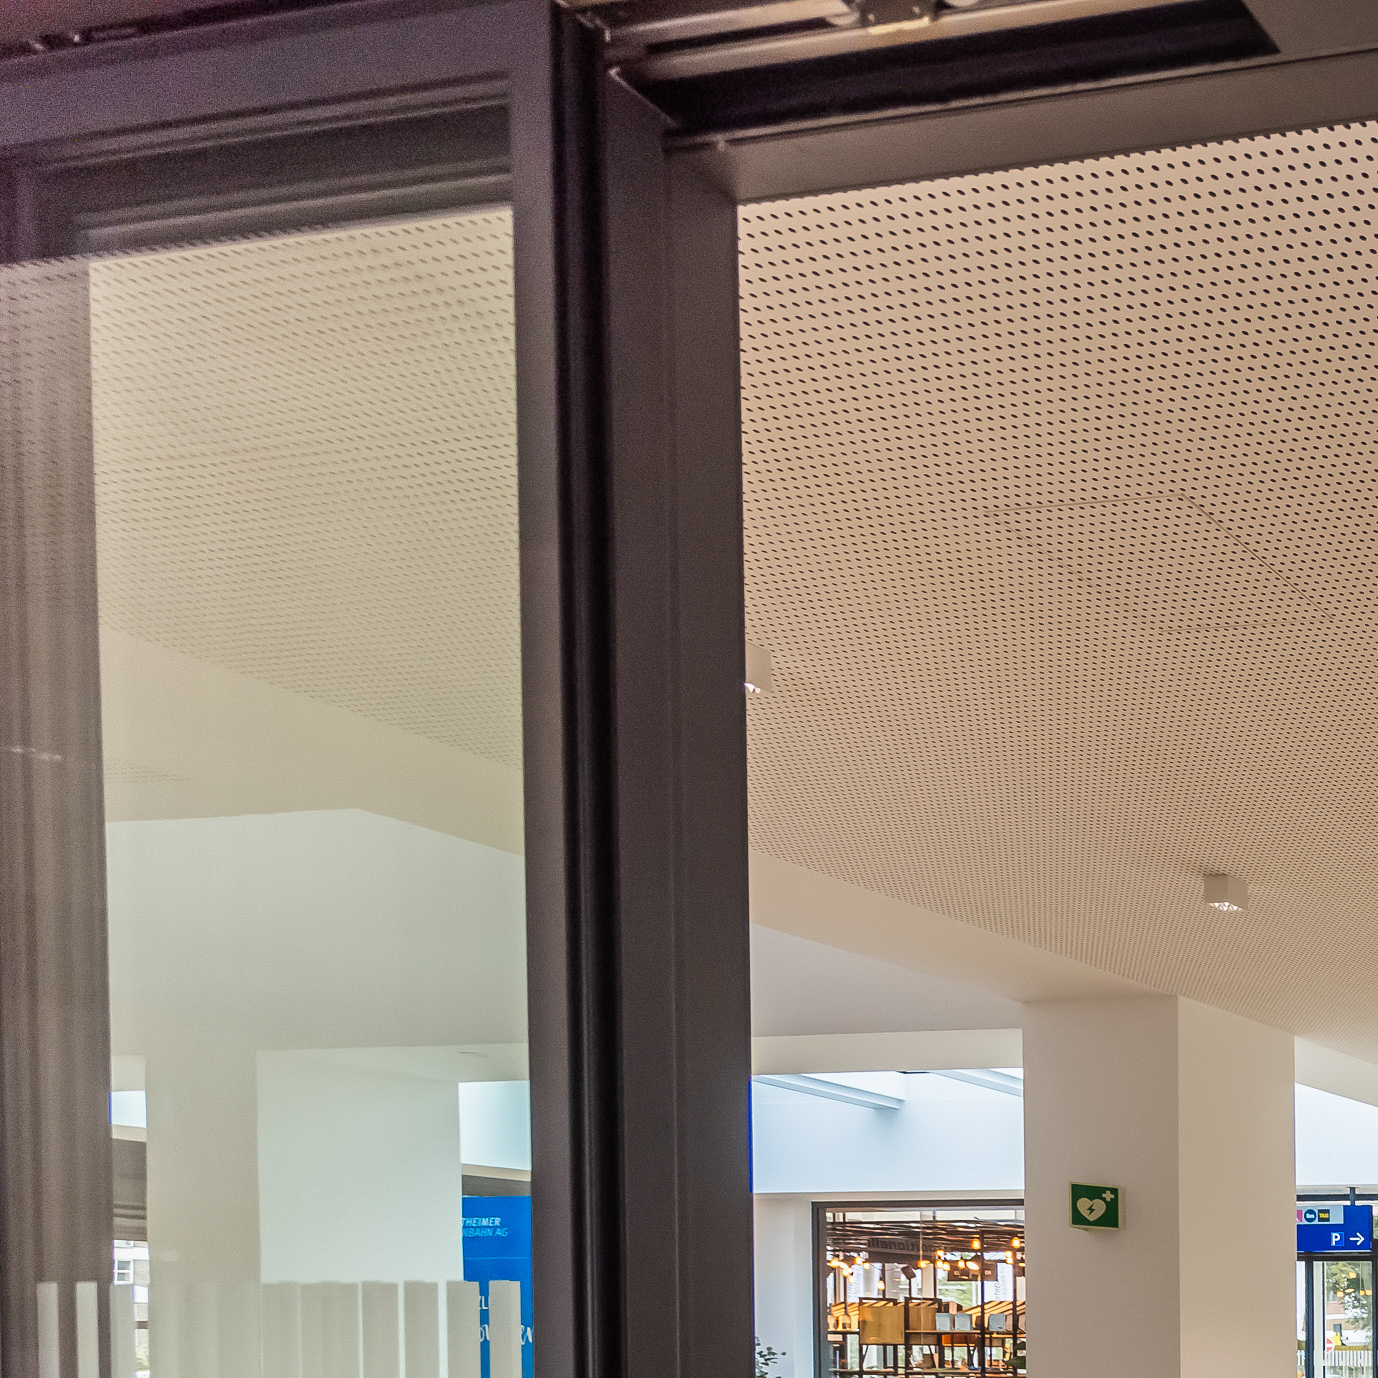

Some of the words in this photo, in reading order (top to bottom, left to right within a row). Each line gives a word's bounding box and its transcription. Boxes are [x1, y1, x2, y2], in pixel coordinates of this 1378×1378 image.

[462, 1217, 501, 1227] THEIMER
[462, 1227, 494, 1238] NBAHN
[494, 1227, 509, 1237] AG
[1332, 1232, 1341, 1246] P
